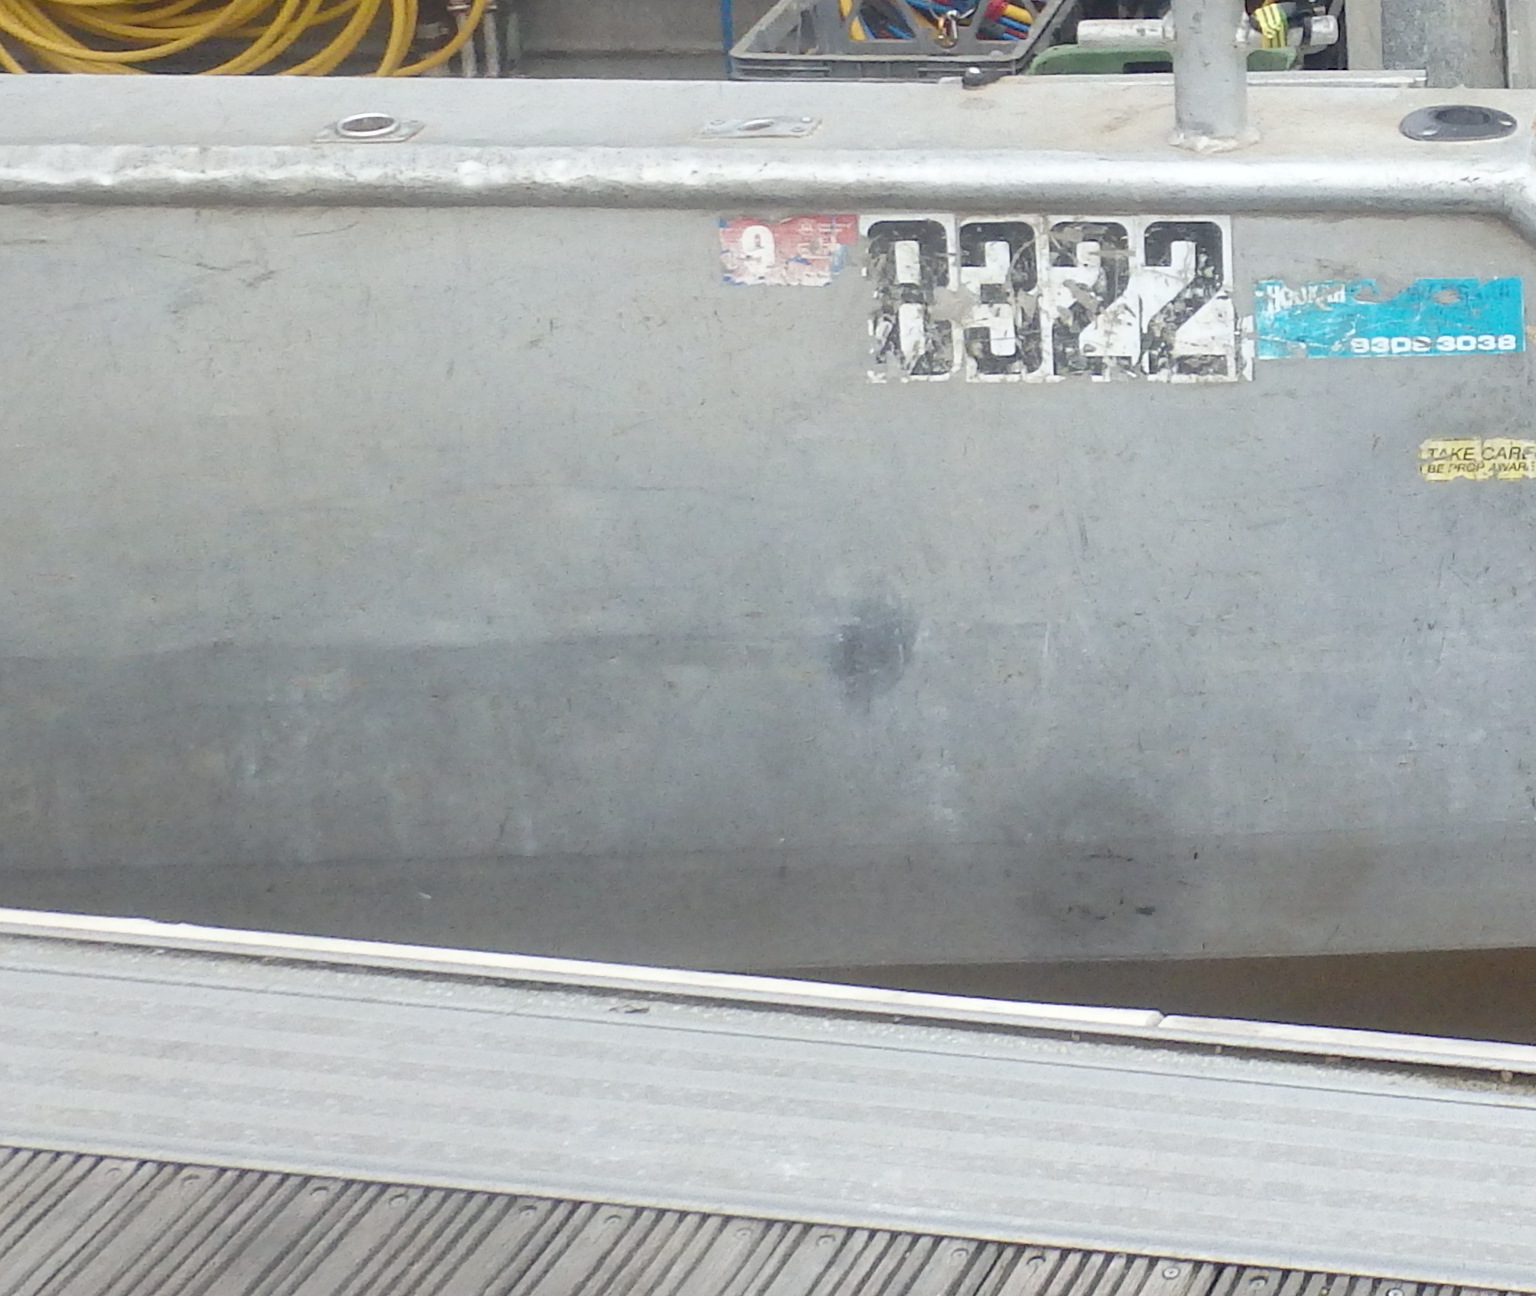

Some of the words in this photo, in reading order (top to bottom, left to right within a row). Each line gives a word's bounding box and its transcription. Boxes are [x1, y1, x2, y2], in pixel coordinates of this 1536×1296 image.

[1436, 335, 1517, 352] 3038
[1428, 447, 1475, 461] TAKE
[1427, 463, 1445, 474] BE
[1448, 462, 1485, 473] PROP
